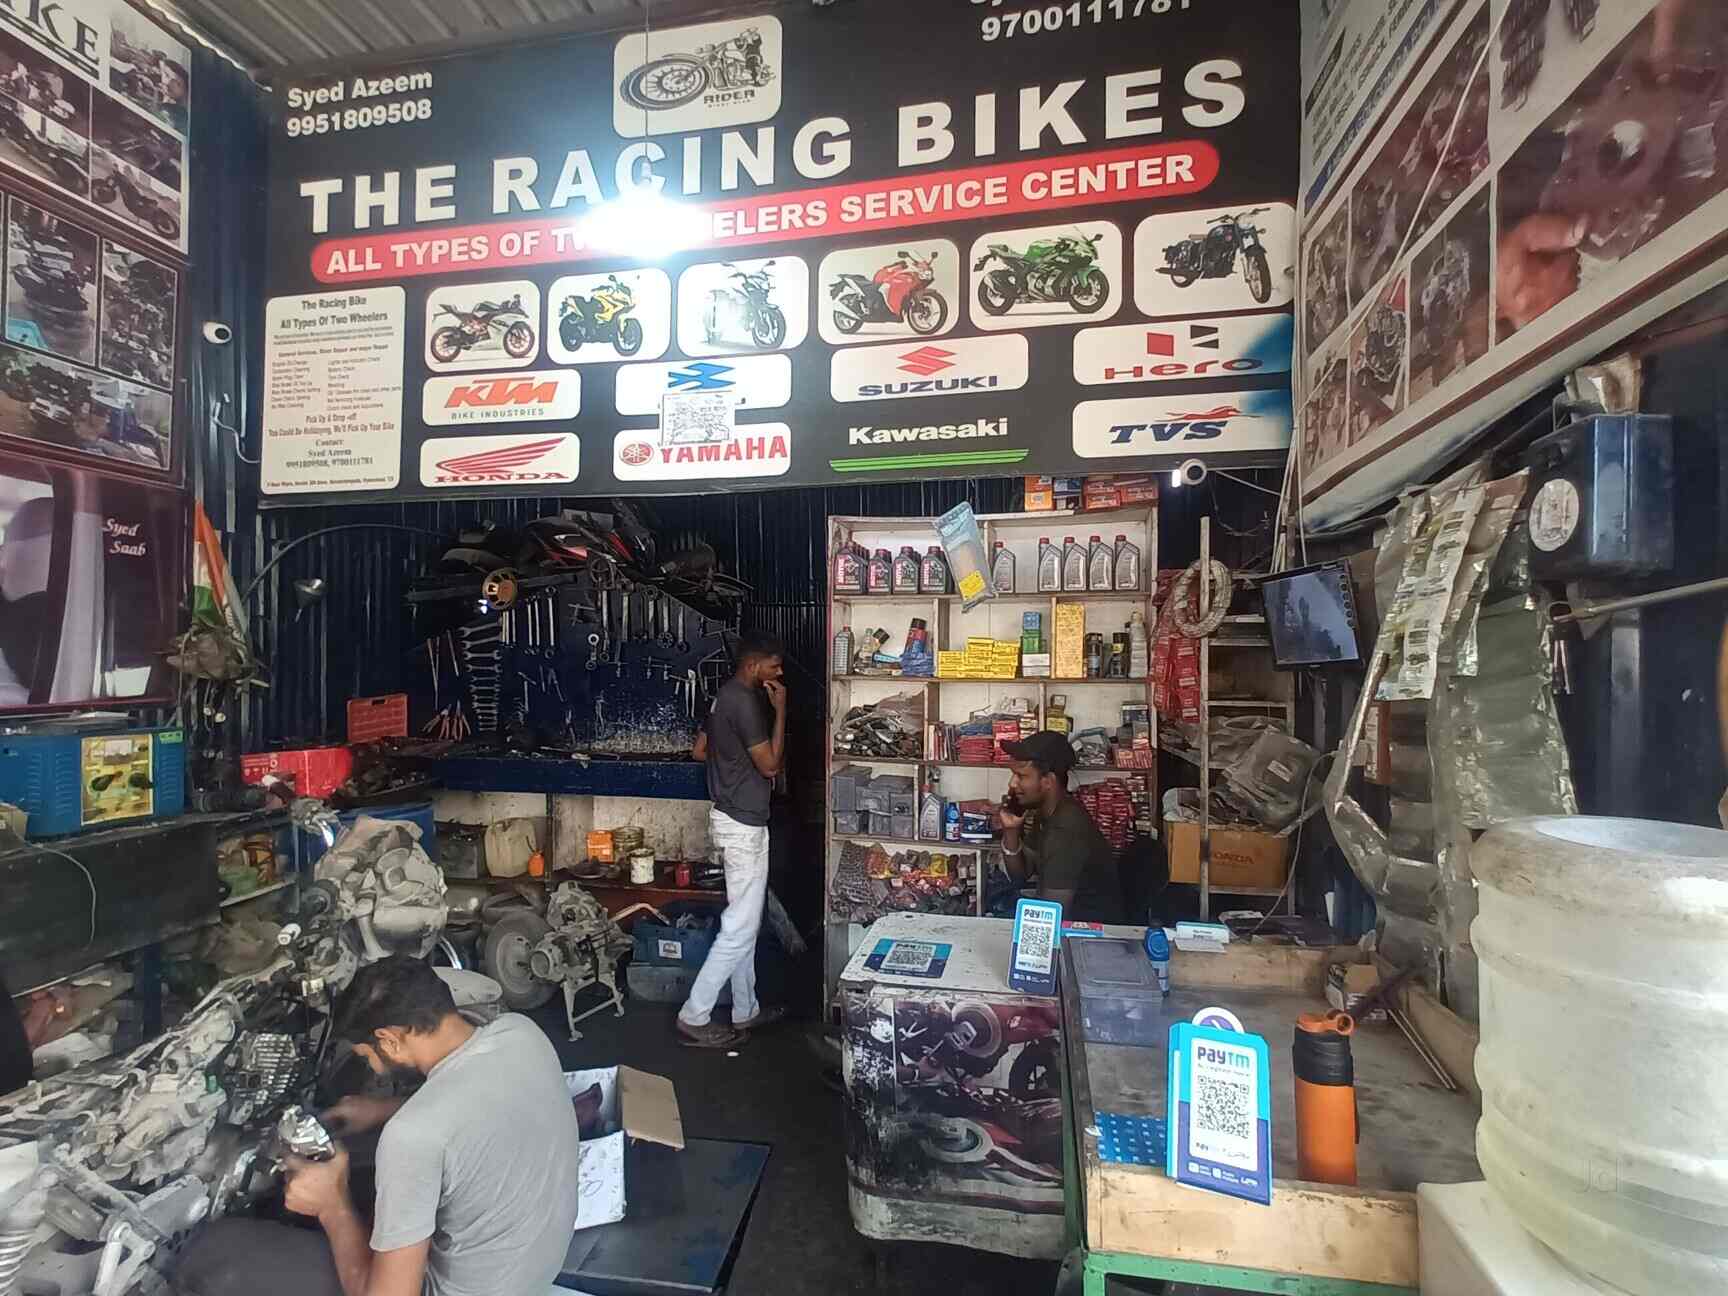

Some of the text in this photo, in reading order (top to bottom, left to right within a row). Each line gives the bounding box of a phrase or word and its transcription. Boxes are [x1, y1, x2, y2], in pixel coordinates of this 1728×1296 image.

[287, 71, 433, 111] Syed Azeem
[287, 99, 432, 137] 9951809508
[300, 165, 456, 233] THE
[492, 117, 851, 215] RACING
[898, 59, 1245, 168] BIKES
[326, 247, 382, 275] ALL
[390, 235, 489, 268] TYPES
[499, 228, 541, 257] OF
[840, 176, 1008, 223] SERVICE
[1021, 154, 1195, 201] CENTER
[302, 296, 367, 310] The Racing Bike
[281, 312, 388, 330] All Types Of Two Wheelers
[1104, 358, 1263, 380] Hero
[444, 377, 559, 408] KTM
[858, 375, 998, 397] SUZUKI
[451, 408, 544, 420] BIKE INDUSTRIES
[849, 417, 1008, 445] Kawasaki
[1109, 421, 1228, 444] TVS
[660, 435, 788, 463] YAMAHA
[434, 472, 569, 483] HONDA
[102, 518, 140, 537] Syed
[109, 541, 146, 556] Saab
